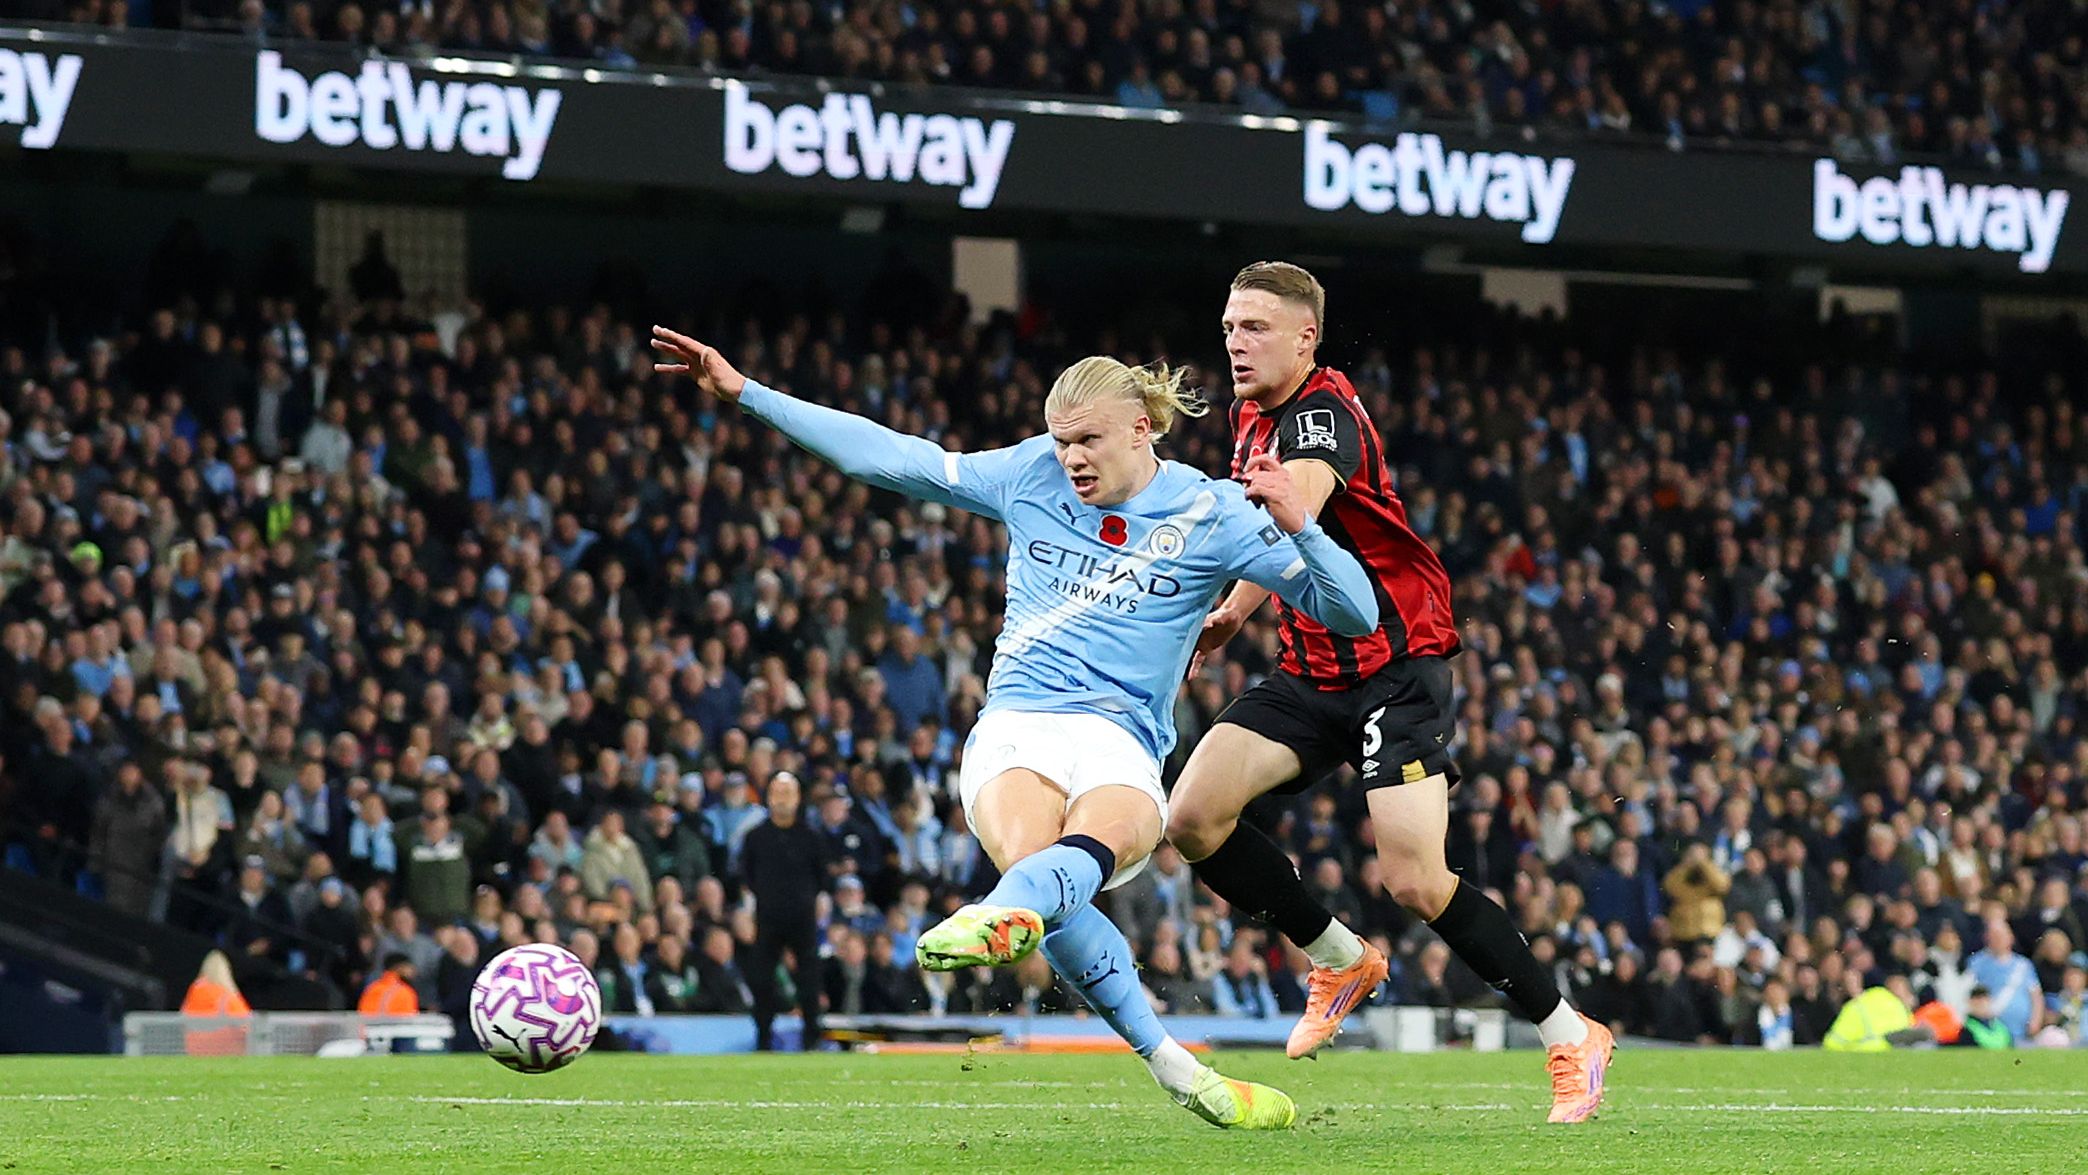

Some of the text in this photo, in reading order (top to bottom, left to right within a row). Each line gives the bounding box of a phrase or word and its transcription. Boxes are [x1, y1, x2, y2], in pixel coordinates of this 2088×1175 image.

[256, 50, 562, 180] betway
[724, 79, 1014, 209] betway
[1304, 119, 1575, 243] betway
[1814, 159, 2068, 272] betway
[1029, 540, 1181, 598] ETIHAD
[1048, 577, 1139, 614] AIRWAYS
[1363, 706, 1386, 757] 3
